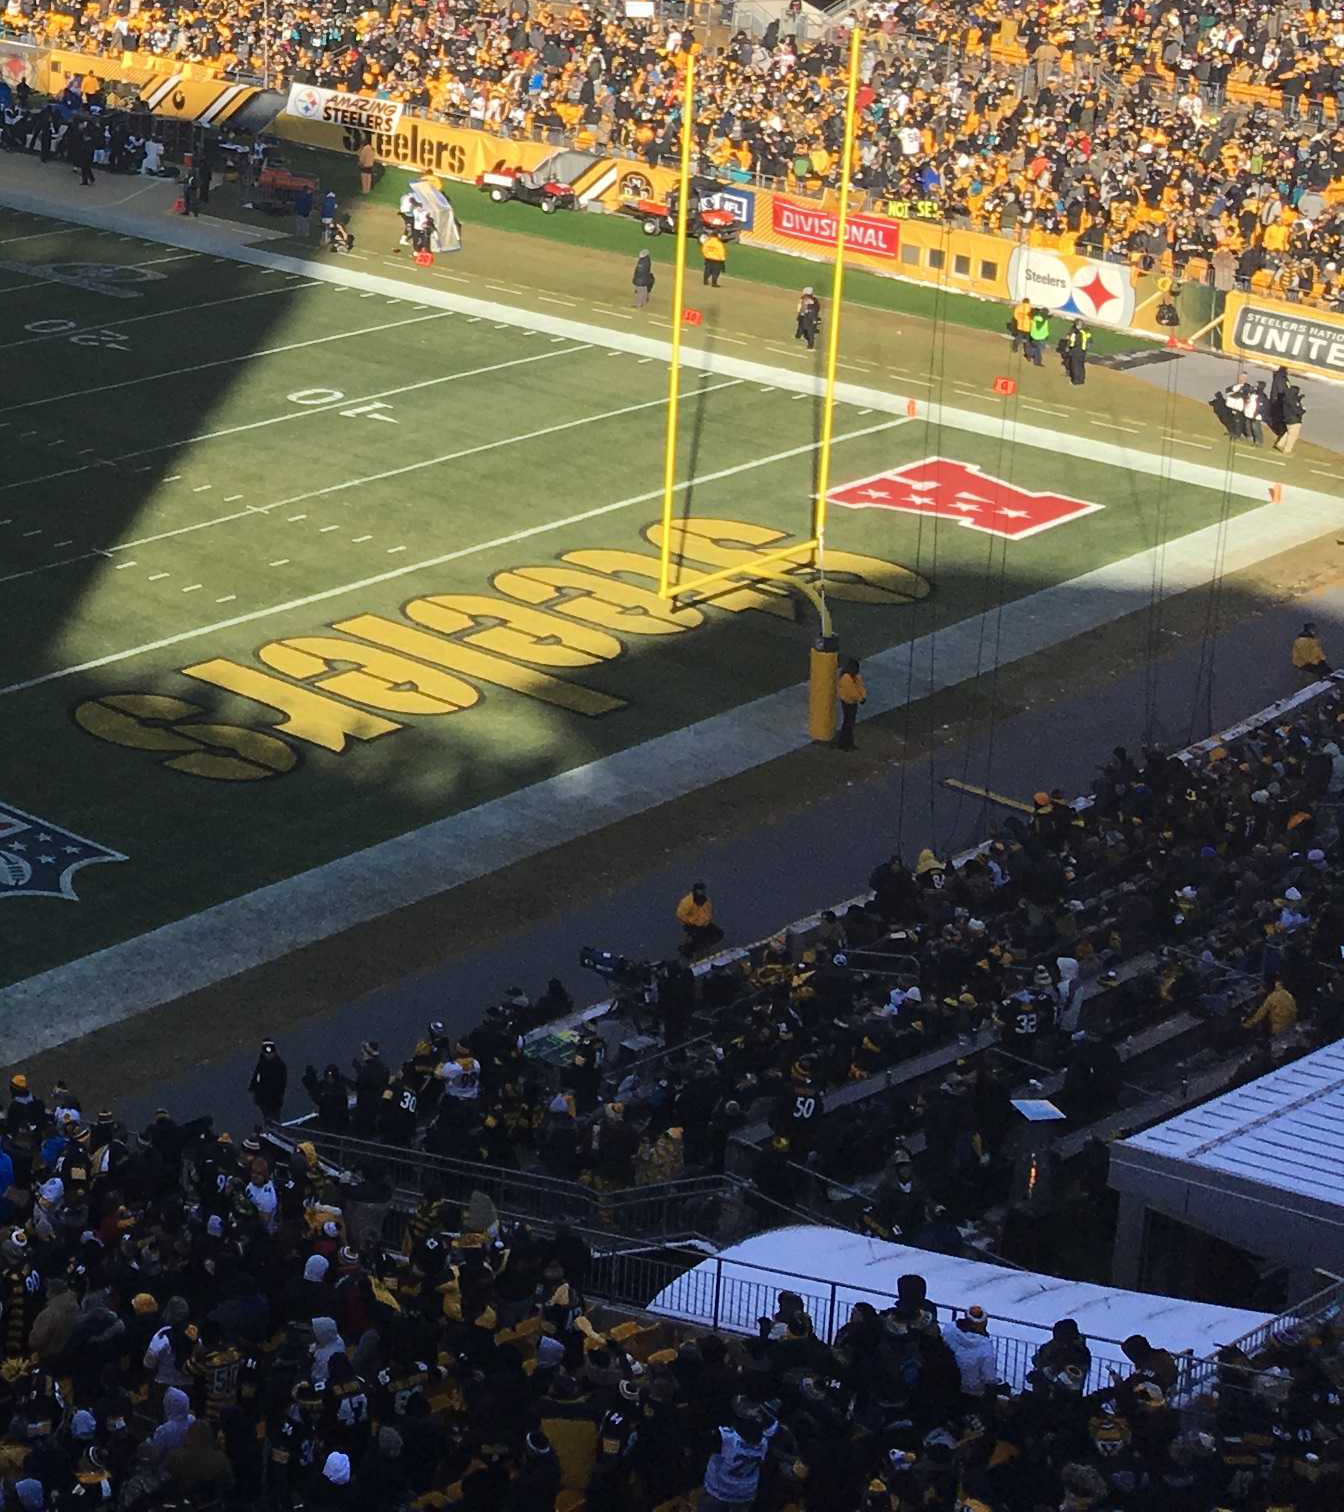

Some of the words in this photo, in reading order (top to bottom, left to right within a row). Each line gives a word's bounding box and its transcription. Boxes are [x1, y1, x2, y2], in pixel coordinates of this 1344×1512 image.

[326, 94, 397, 115] AMAZING
[323, 106, 393, 133] STEELERS
[342, 123, 467, 175] Steelers
[723, 199, 742, 215] NFL
[782, 209, 887, 249] DIVISIONAL
[1025, 268, 1066, 289] Steelers
[24, 319, 129, 347] 20
[1247, 312, 1307, 333] STEELERS
[1241, 322, 1344, 366] UNITE
[286, 388, 395, 418] 10
[69, 514, 937, 784] Steelers
[1014, 1013, 1037, 1033] 32
[399, 1087, 418, 1113] 30
[793, 1096, 816, 1119] 50
